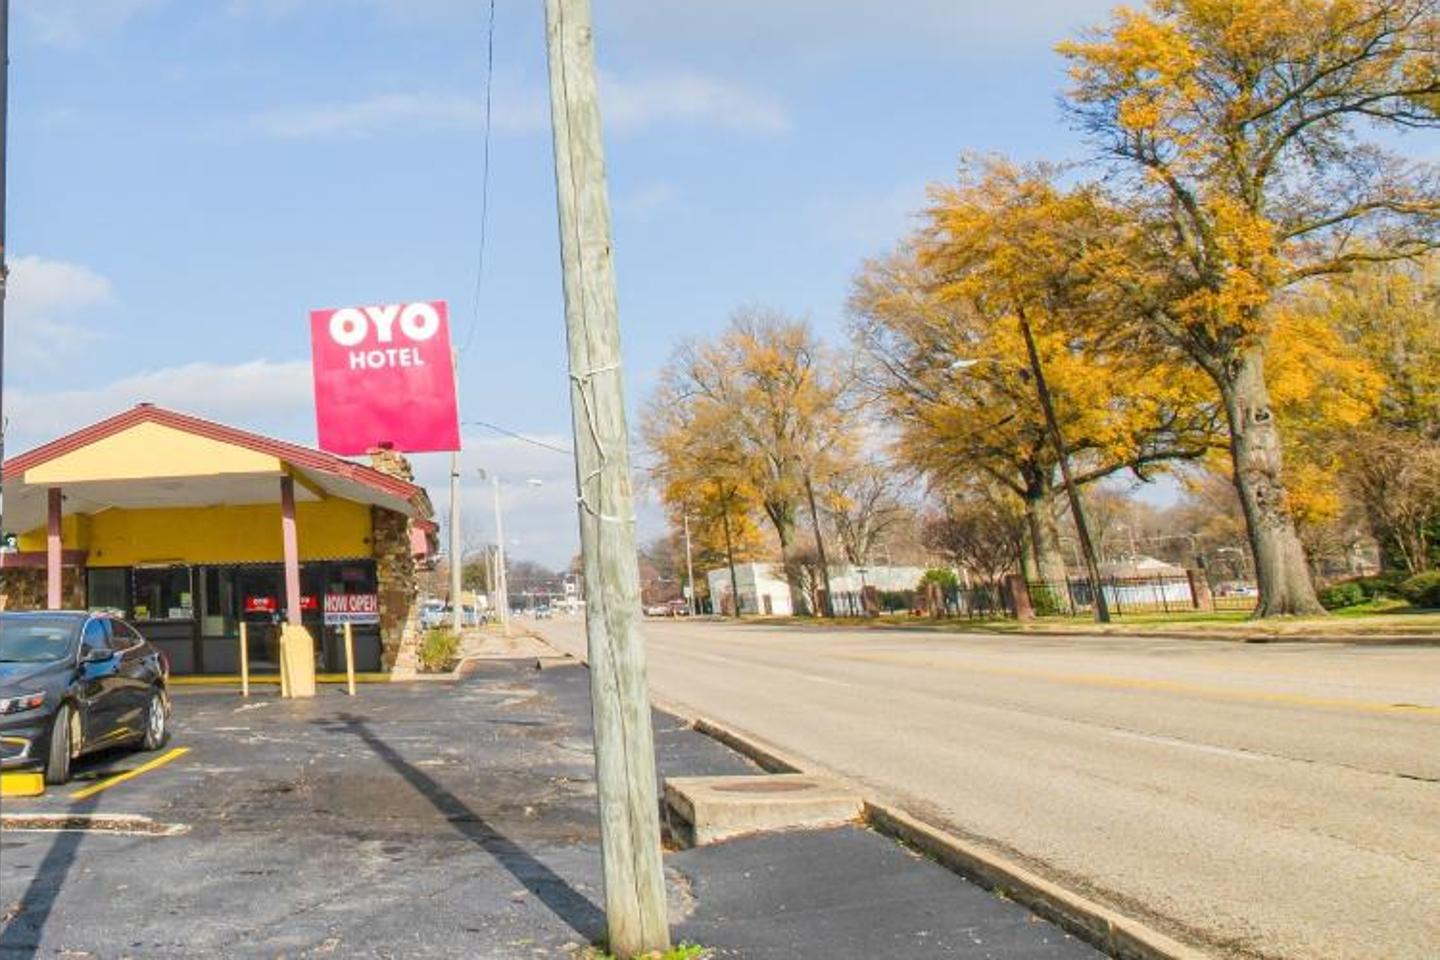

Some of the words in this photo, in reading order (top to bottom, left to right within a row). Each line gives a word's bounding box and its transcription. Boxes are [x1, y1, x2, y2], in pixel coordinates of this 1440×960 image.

[329, 302, 440, 347] OYO
[348, 347, 424, 370] HOTEL
[324, 592, 348, 612] NOW
[349, 593, 378, 612] OPEN
